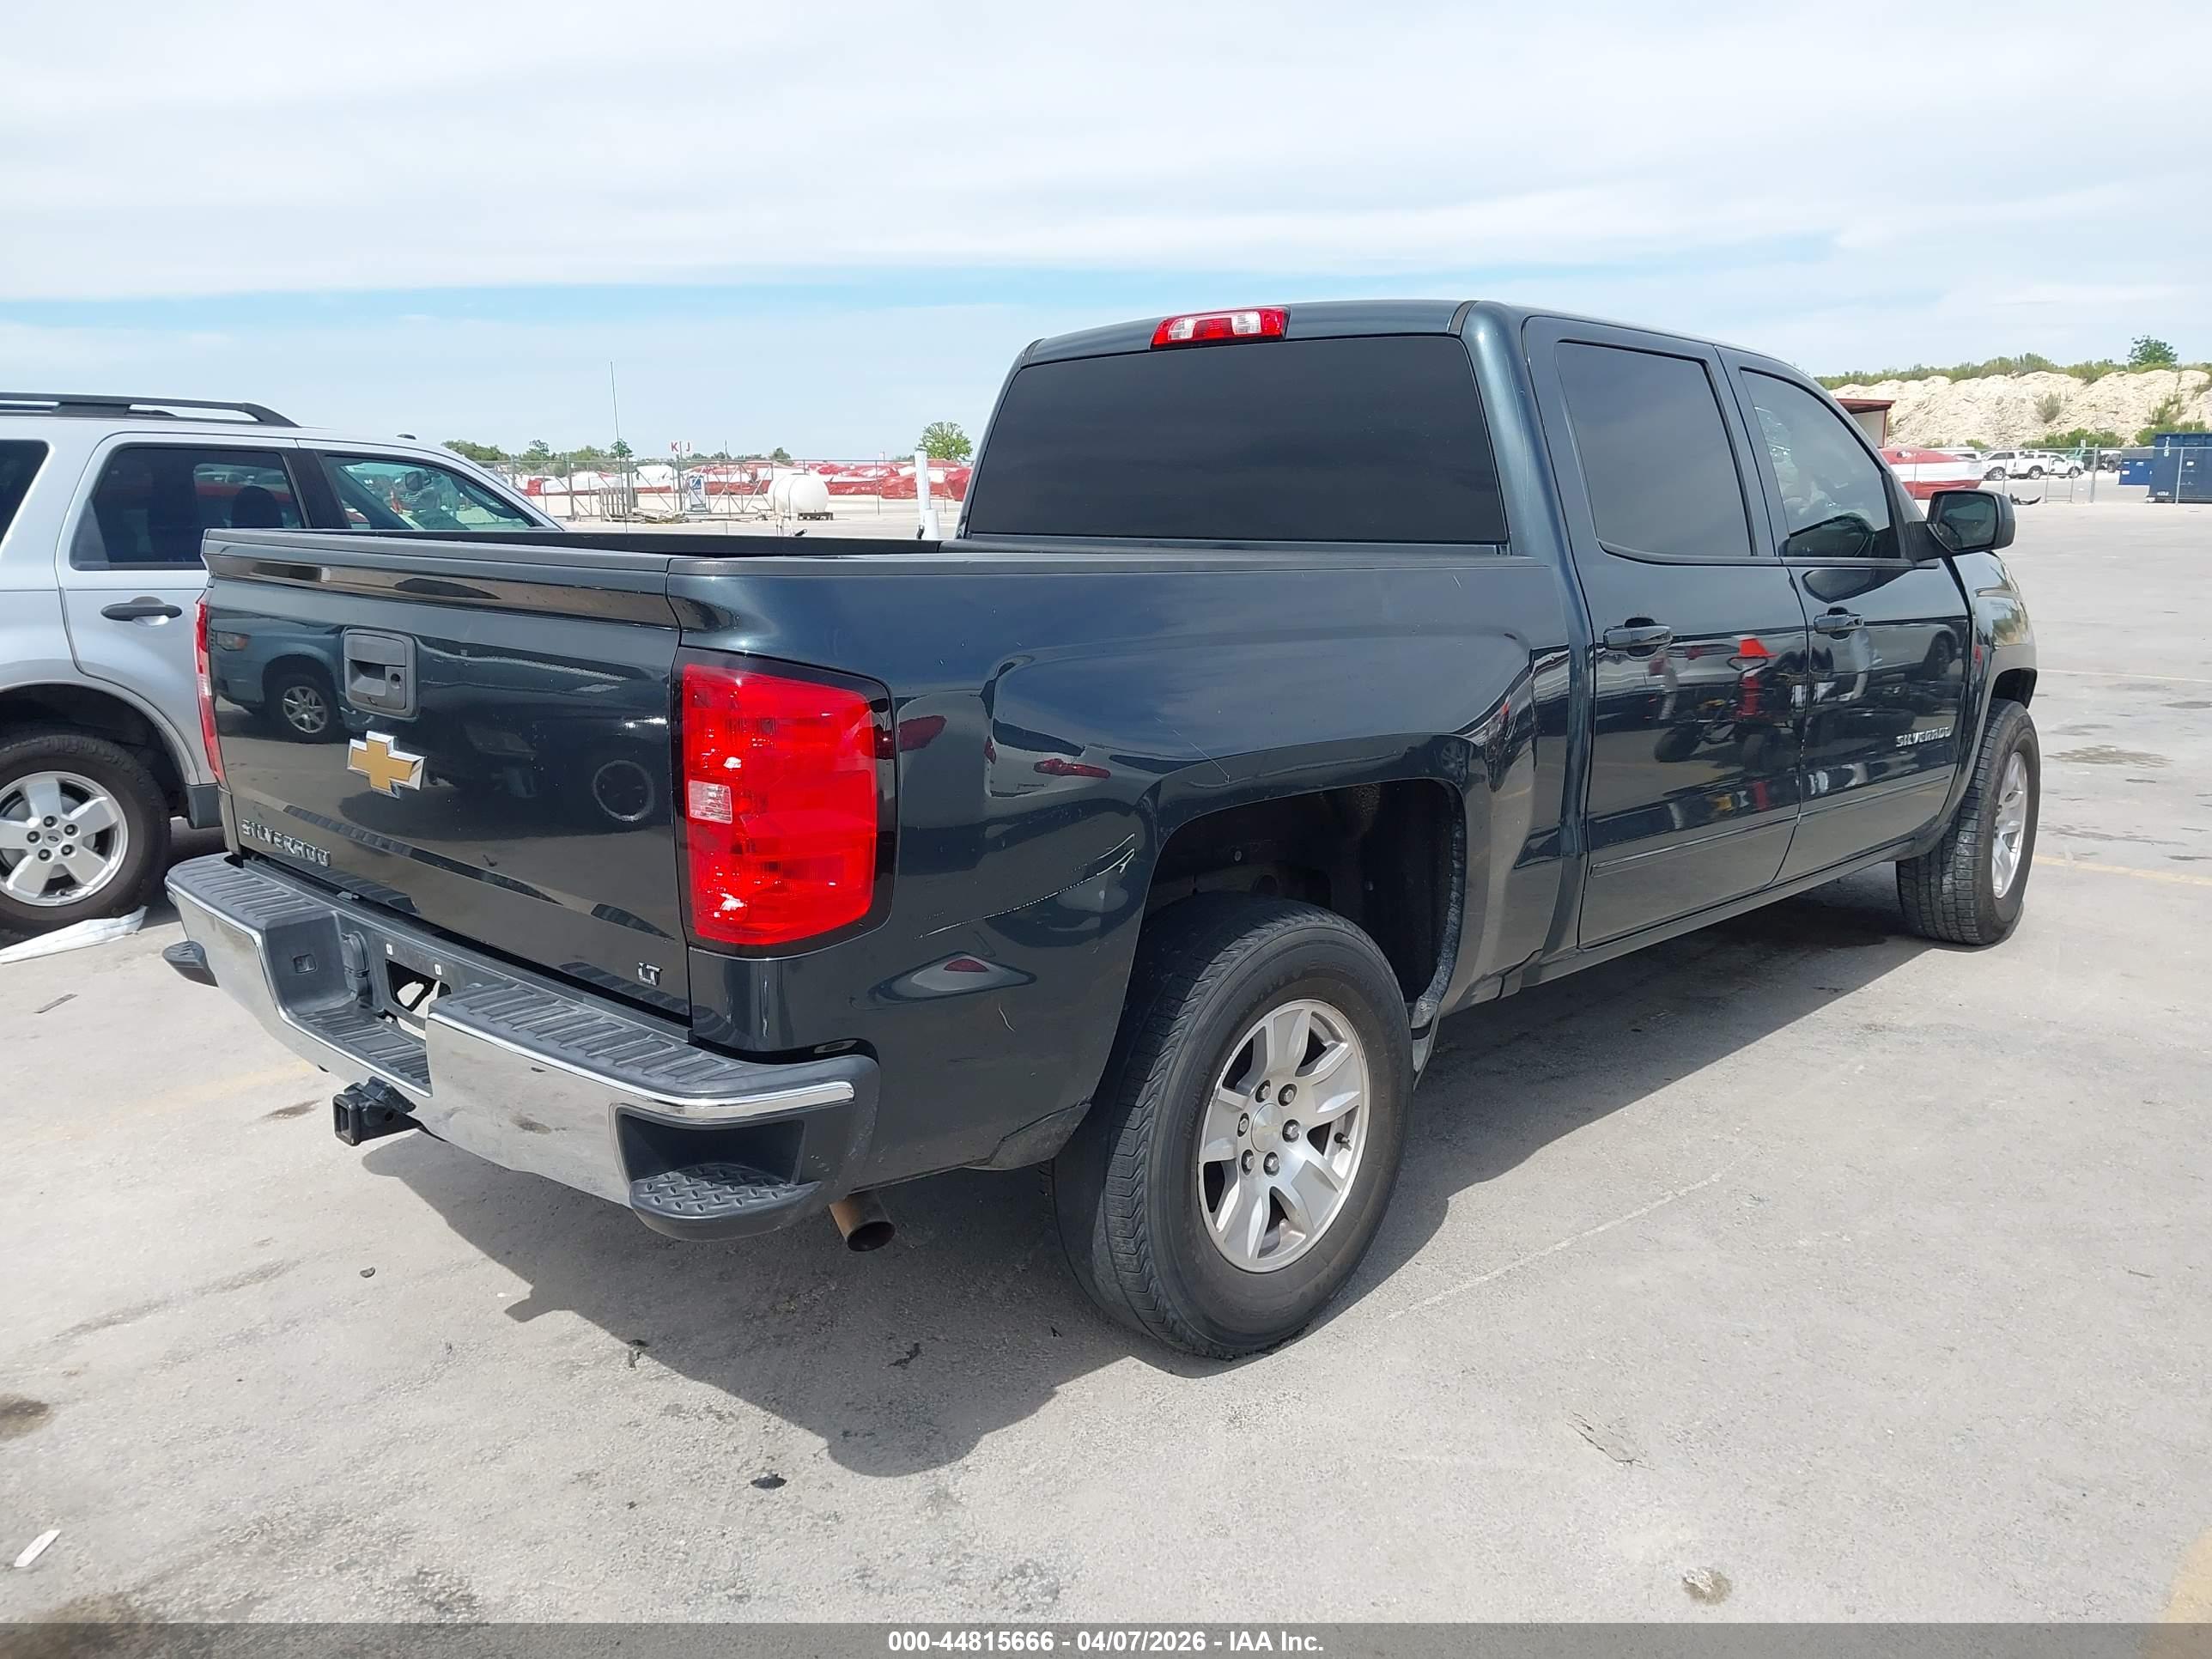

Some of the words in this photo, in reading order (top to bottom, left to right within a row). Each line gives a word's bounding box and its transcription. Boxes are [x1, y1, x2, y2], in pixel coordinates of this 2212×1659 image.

[671, 441, 679, 453] K
[685, 441, 691, 453] J
[1895, 726, 1952, 748] SILVERADO
[241, 818, 331, 867] SILVERADO
[638, 962, 661, 987] LT
